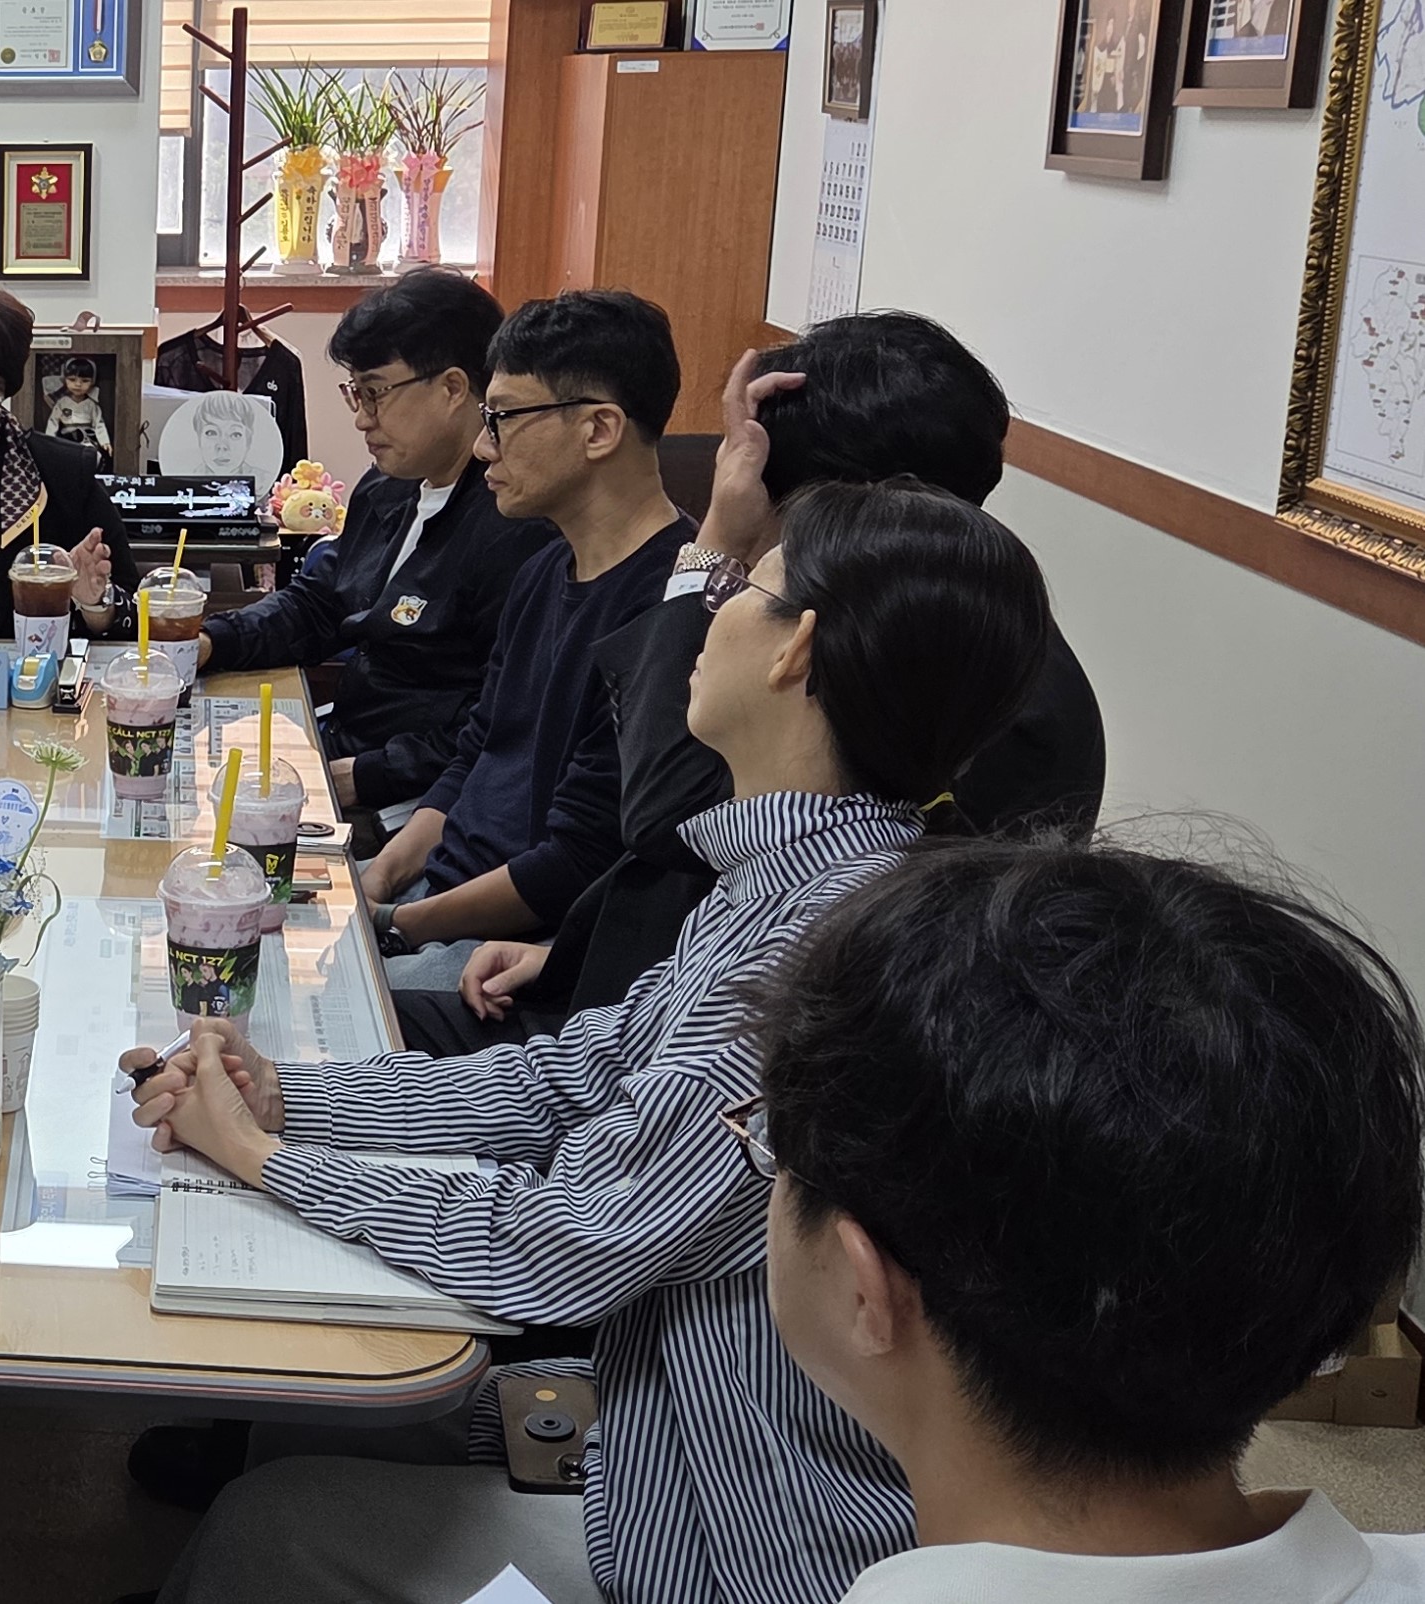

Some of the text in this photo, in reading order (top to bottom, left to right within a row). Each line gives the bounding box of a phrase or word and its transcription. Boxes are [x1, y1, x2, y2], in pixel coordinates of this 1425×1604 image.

[136, 730, 157, 739] NCT
[158, 729, 172, 737] 127
[175, 950, 199, 964] NCT
[202, 955, 224, 967] 127
